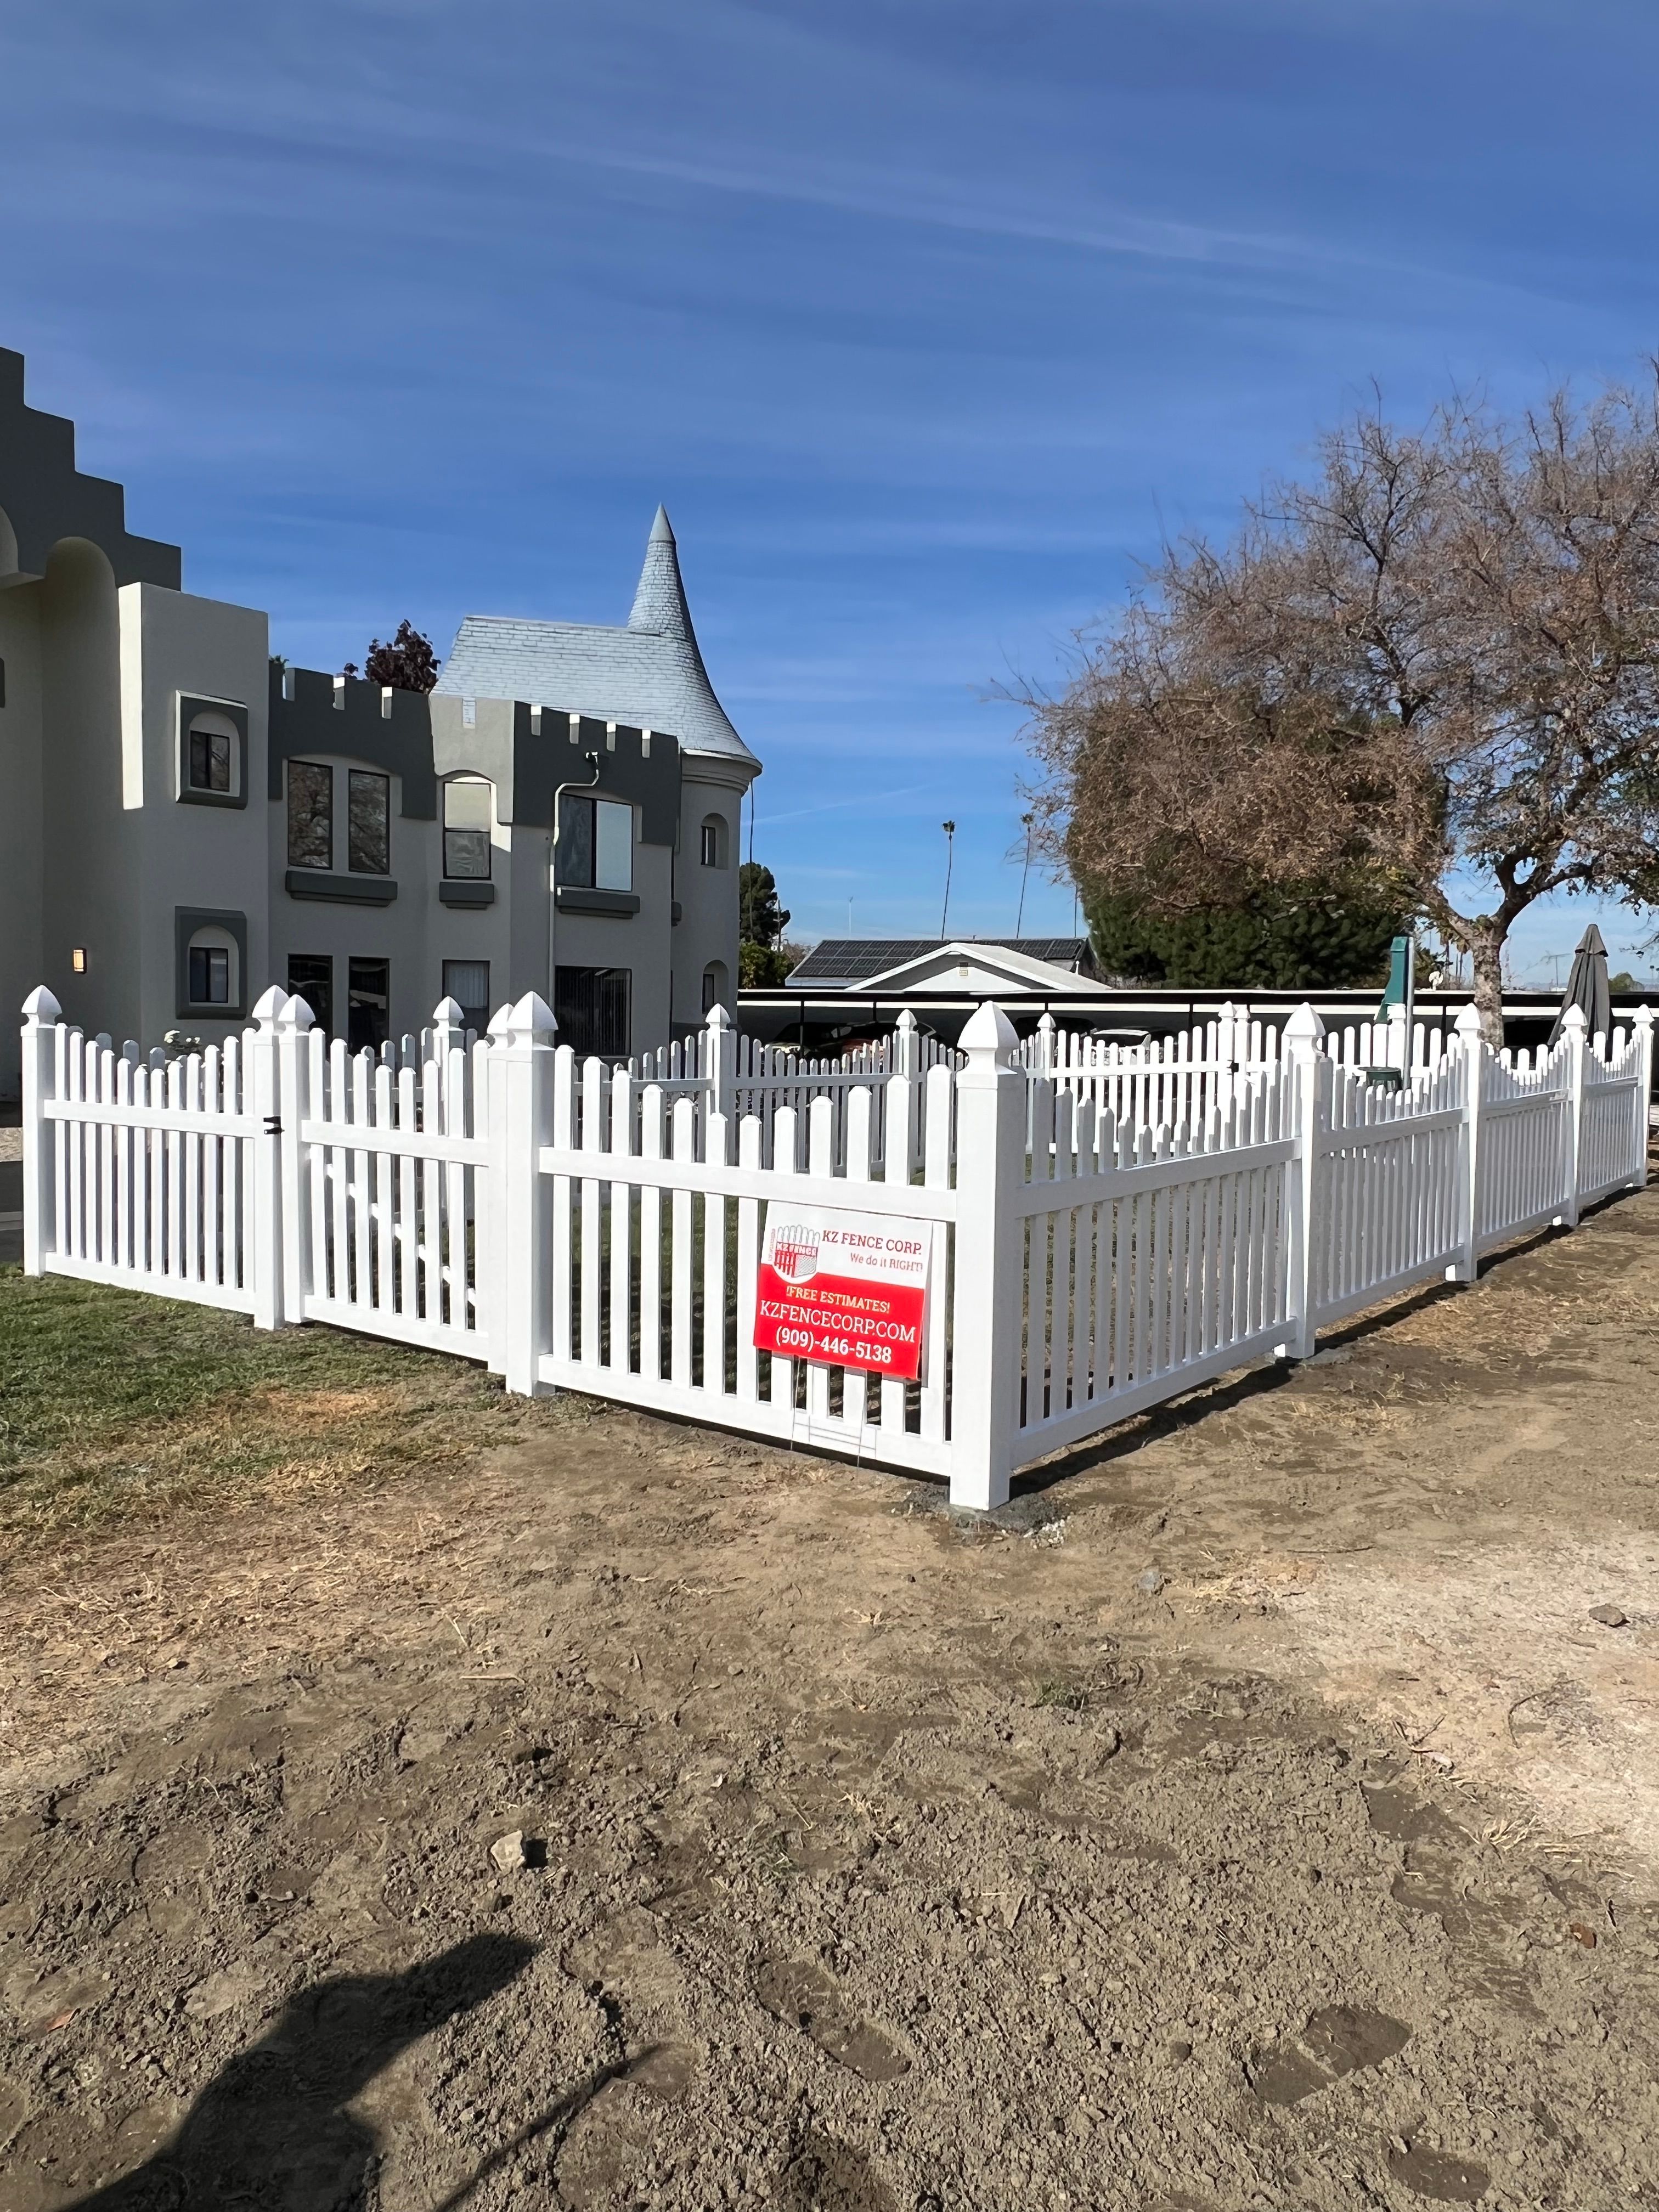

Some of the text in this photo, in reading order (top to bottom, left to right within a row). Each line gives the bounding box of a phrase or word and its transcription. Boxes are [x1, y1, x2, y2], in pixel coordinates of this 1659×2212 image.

[822, 1231, 922, 1255] KZ FENCE CORP.
[850, 1253, 864, 1263] We
[867, 1255, 877, 1265] do
[880, 1257, 887, 1267] it
[820, 1292, 890, 1314] ESTIMATES!
[760, 1300, 916, 1343] KZFENCECORP.COM
[776, 1325, 891, 1363] (909)-446-5138
